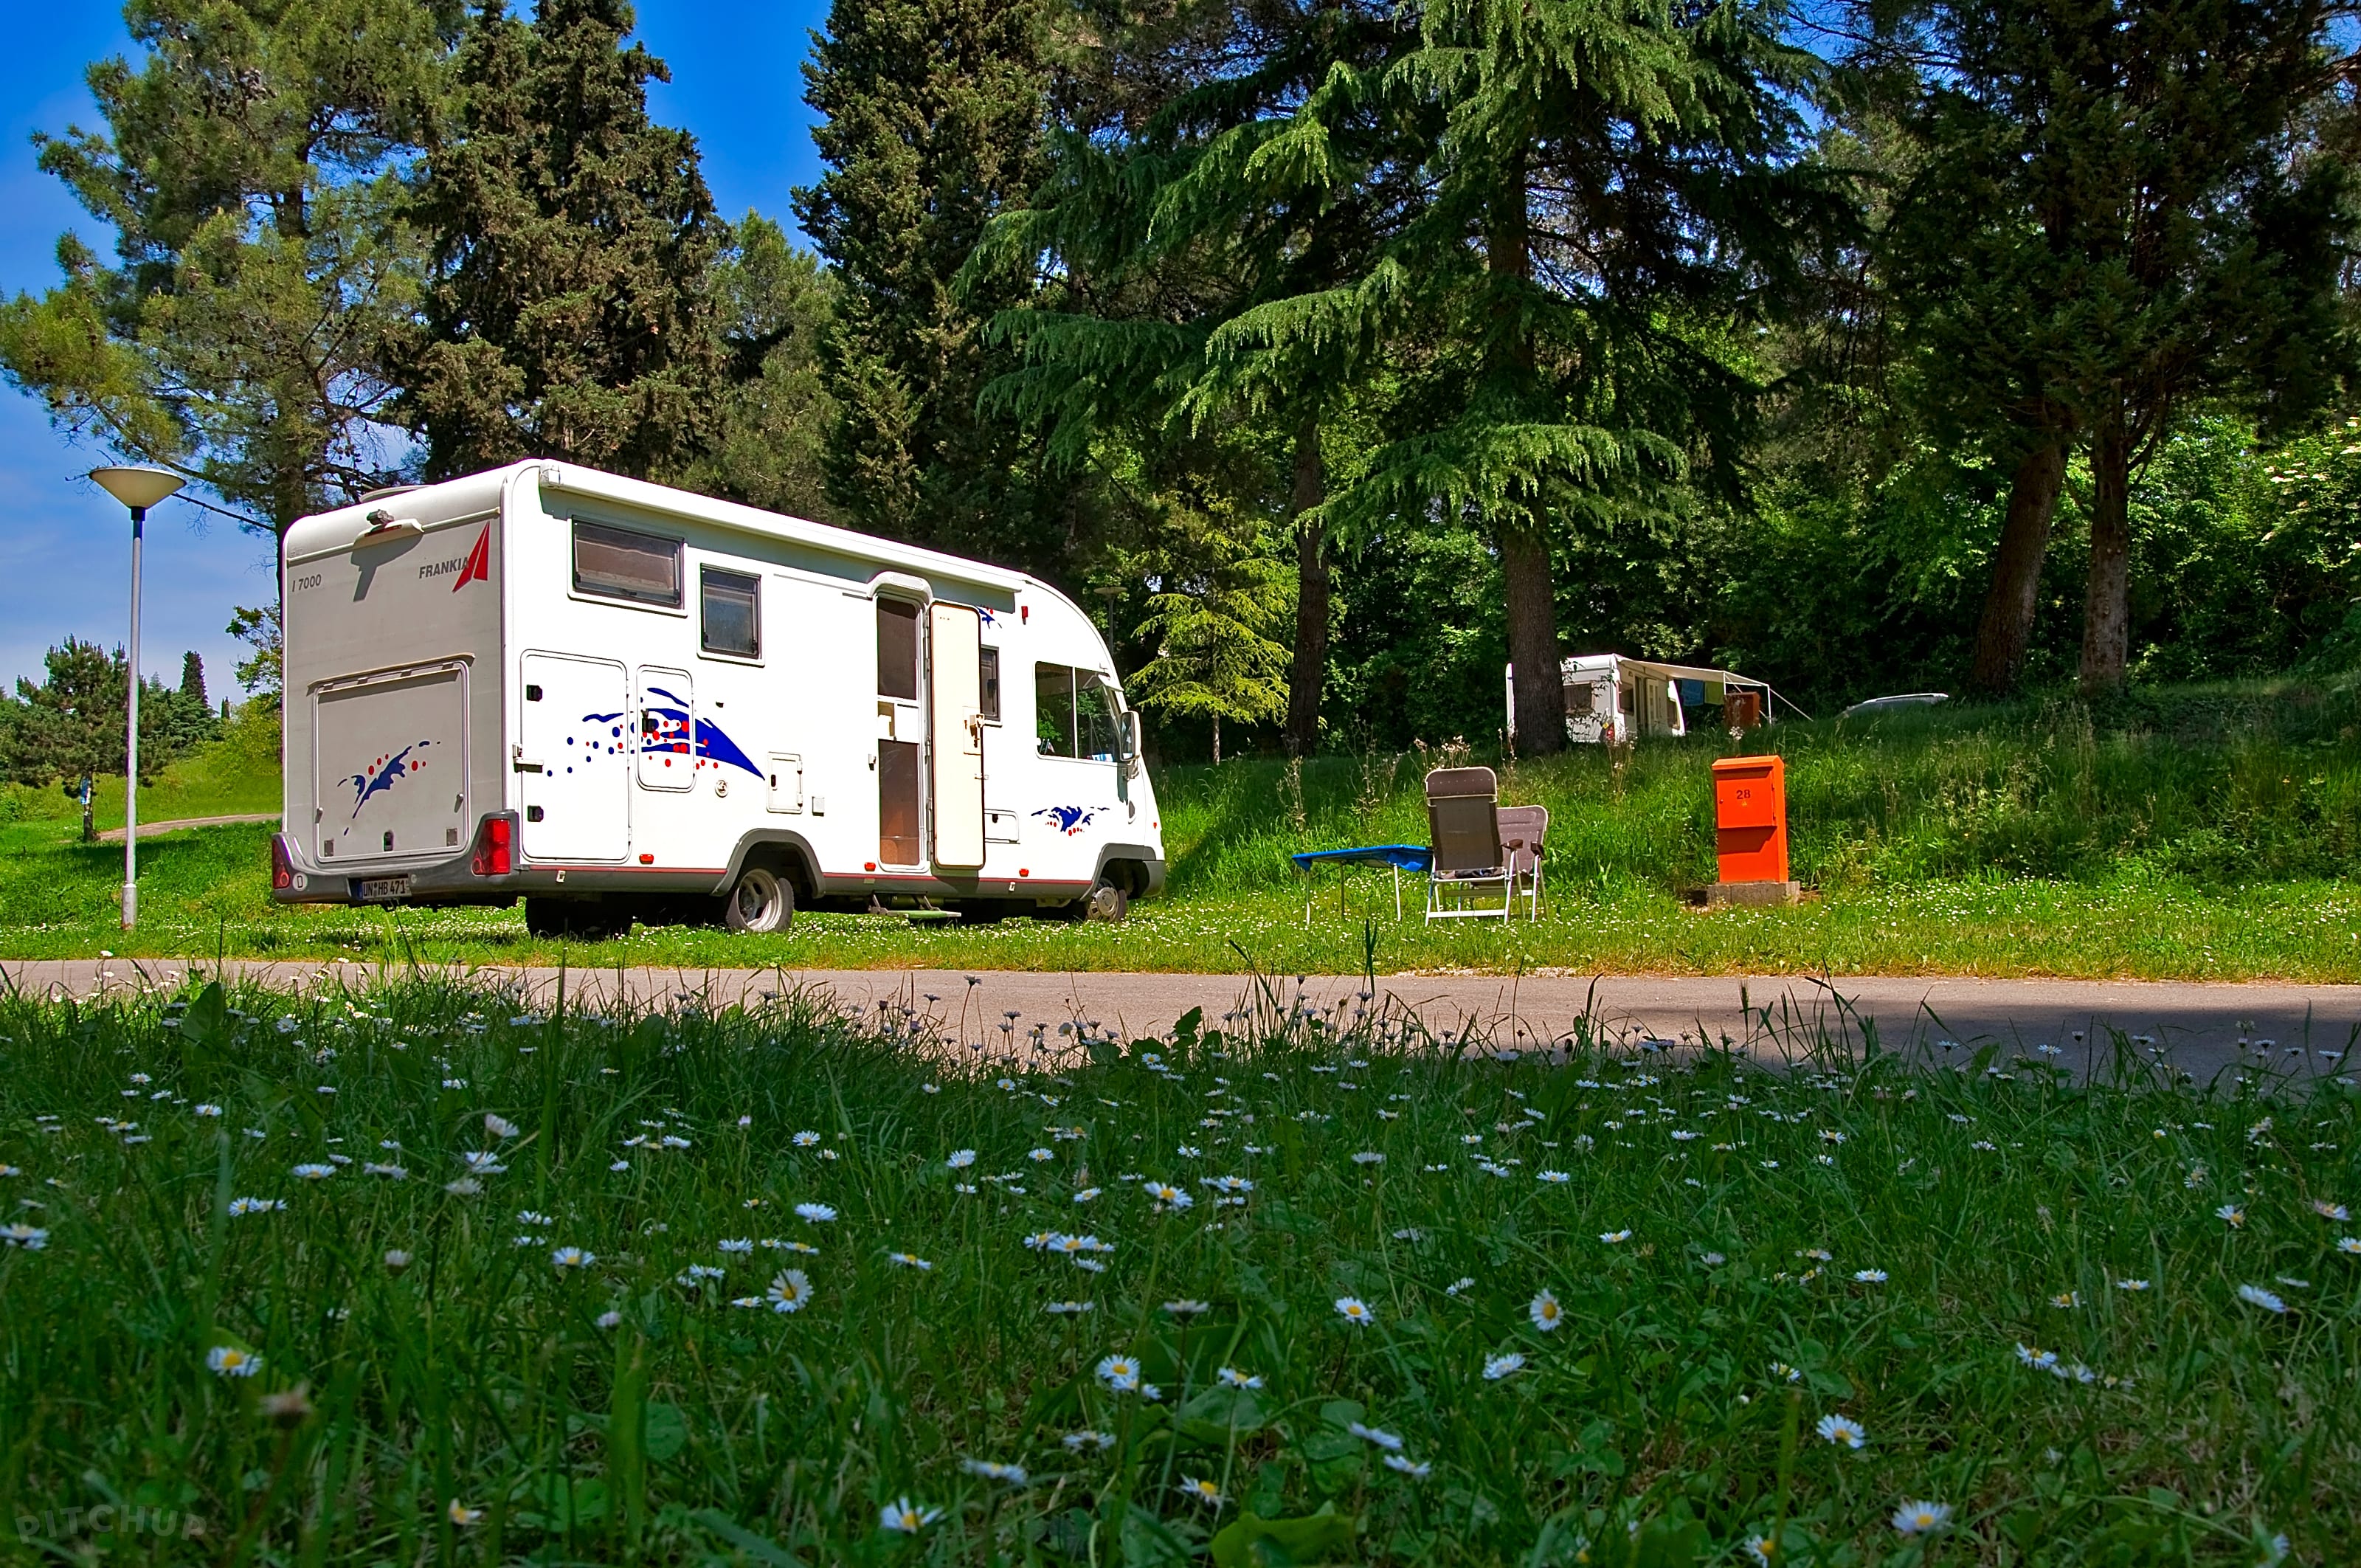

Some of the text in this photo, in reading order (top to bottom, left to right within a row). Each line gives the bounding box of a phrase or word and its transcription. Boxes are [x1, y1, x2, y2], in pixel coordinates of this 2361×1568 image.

[418, 556, 469, 579] FRANKIA
[298, 573, 322, 591] 7000
[1736, 789, 1751, 800] 28
[390, 880, 406, 895] 471
